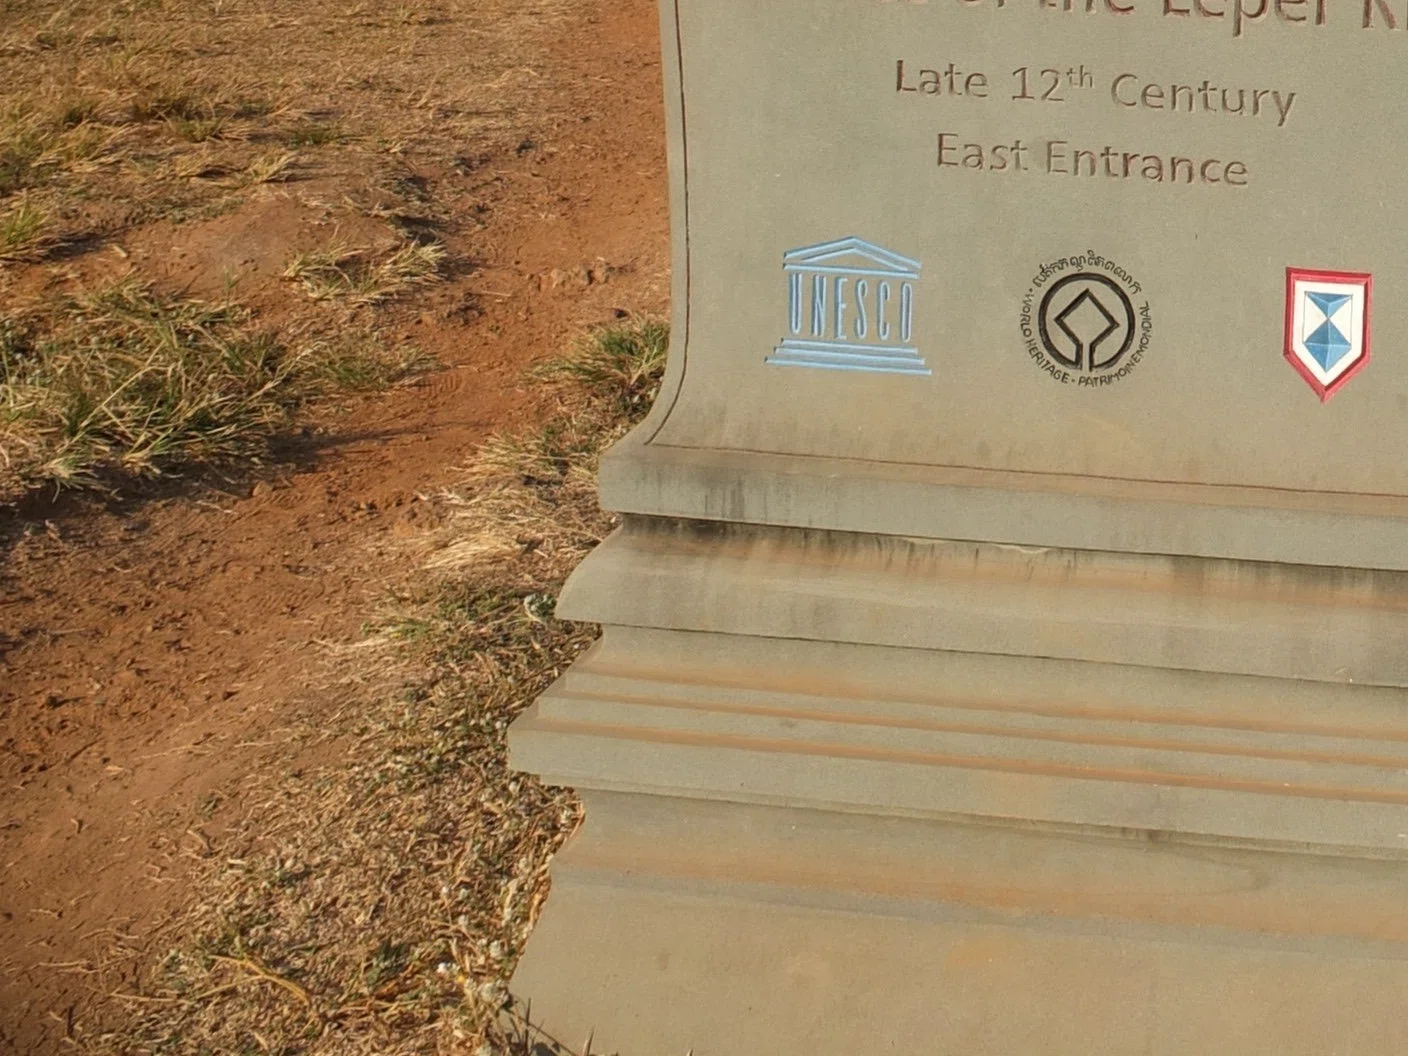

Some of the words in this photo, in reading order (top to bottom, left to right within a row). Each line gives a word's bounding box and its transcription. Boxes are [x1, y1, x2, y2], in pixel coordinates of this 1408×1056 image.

[895, 59, 988, 100] Late
[1110, 72, 1297, 126] Century
[936, 132, 1028, 172] East
[1045, 140, 1249, 187] Entrance
[788, 272, 913, 344] UNESCO
[1024, 338, 1071, 384] HERITAGE
